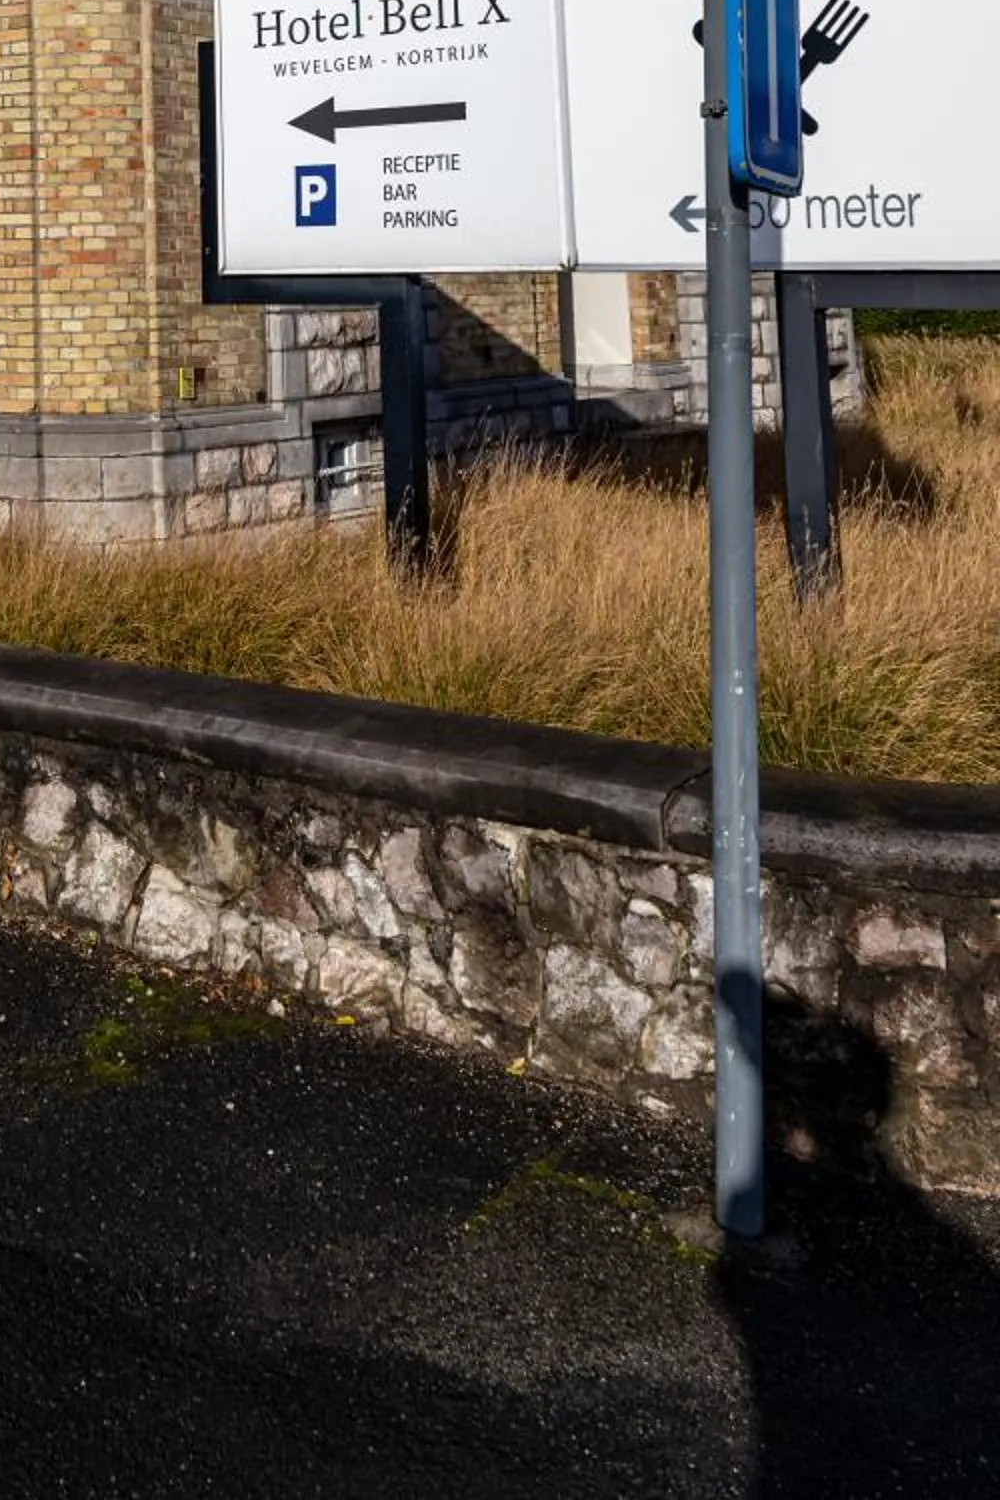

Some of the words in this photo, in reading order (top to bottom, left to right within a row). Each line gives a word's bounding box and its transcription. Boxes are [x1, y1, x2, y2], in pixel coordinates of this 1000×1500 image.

[273, 55, 374, 78] WEVELGEM
[397, 43, 490, 67] KORTRIJK
[383, 154, 461, 174] RECEPTIE
[301, 175, 328, 217] P
[383, 184, 418, 201] BAR
[383, 210, 459, 230] PARKING
[805, 184, 922, 230] meter
